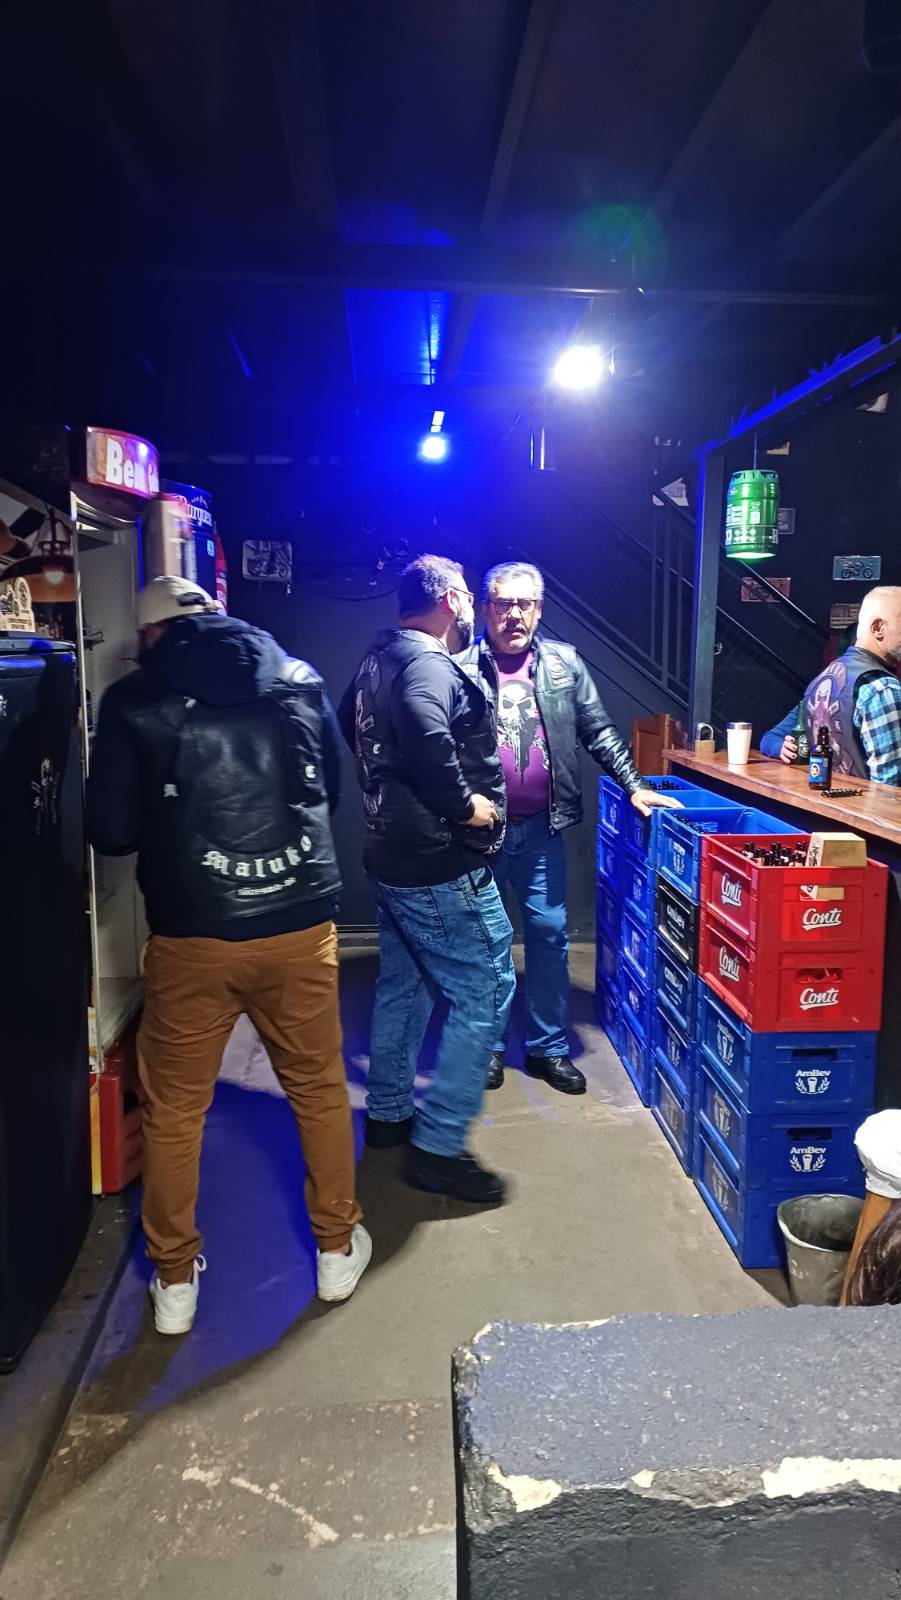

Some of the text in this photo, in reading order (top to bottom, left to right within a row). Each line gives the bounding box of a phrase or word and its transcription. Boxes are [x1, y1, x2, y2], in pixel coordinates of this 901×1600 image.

[200, 834, 312, 878] Maluko
[721, 872, 742, 907] Conti
[802, 908, 842, 931] Conti
[719, 946, 740, 982] Conti
[799, 987, 839, 1011] Conti
[795, 1068, 831, 1078] AmBev
[789, 1145, 827, 1155] AmBev
